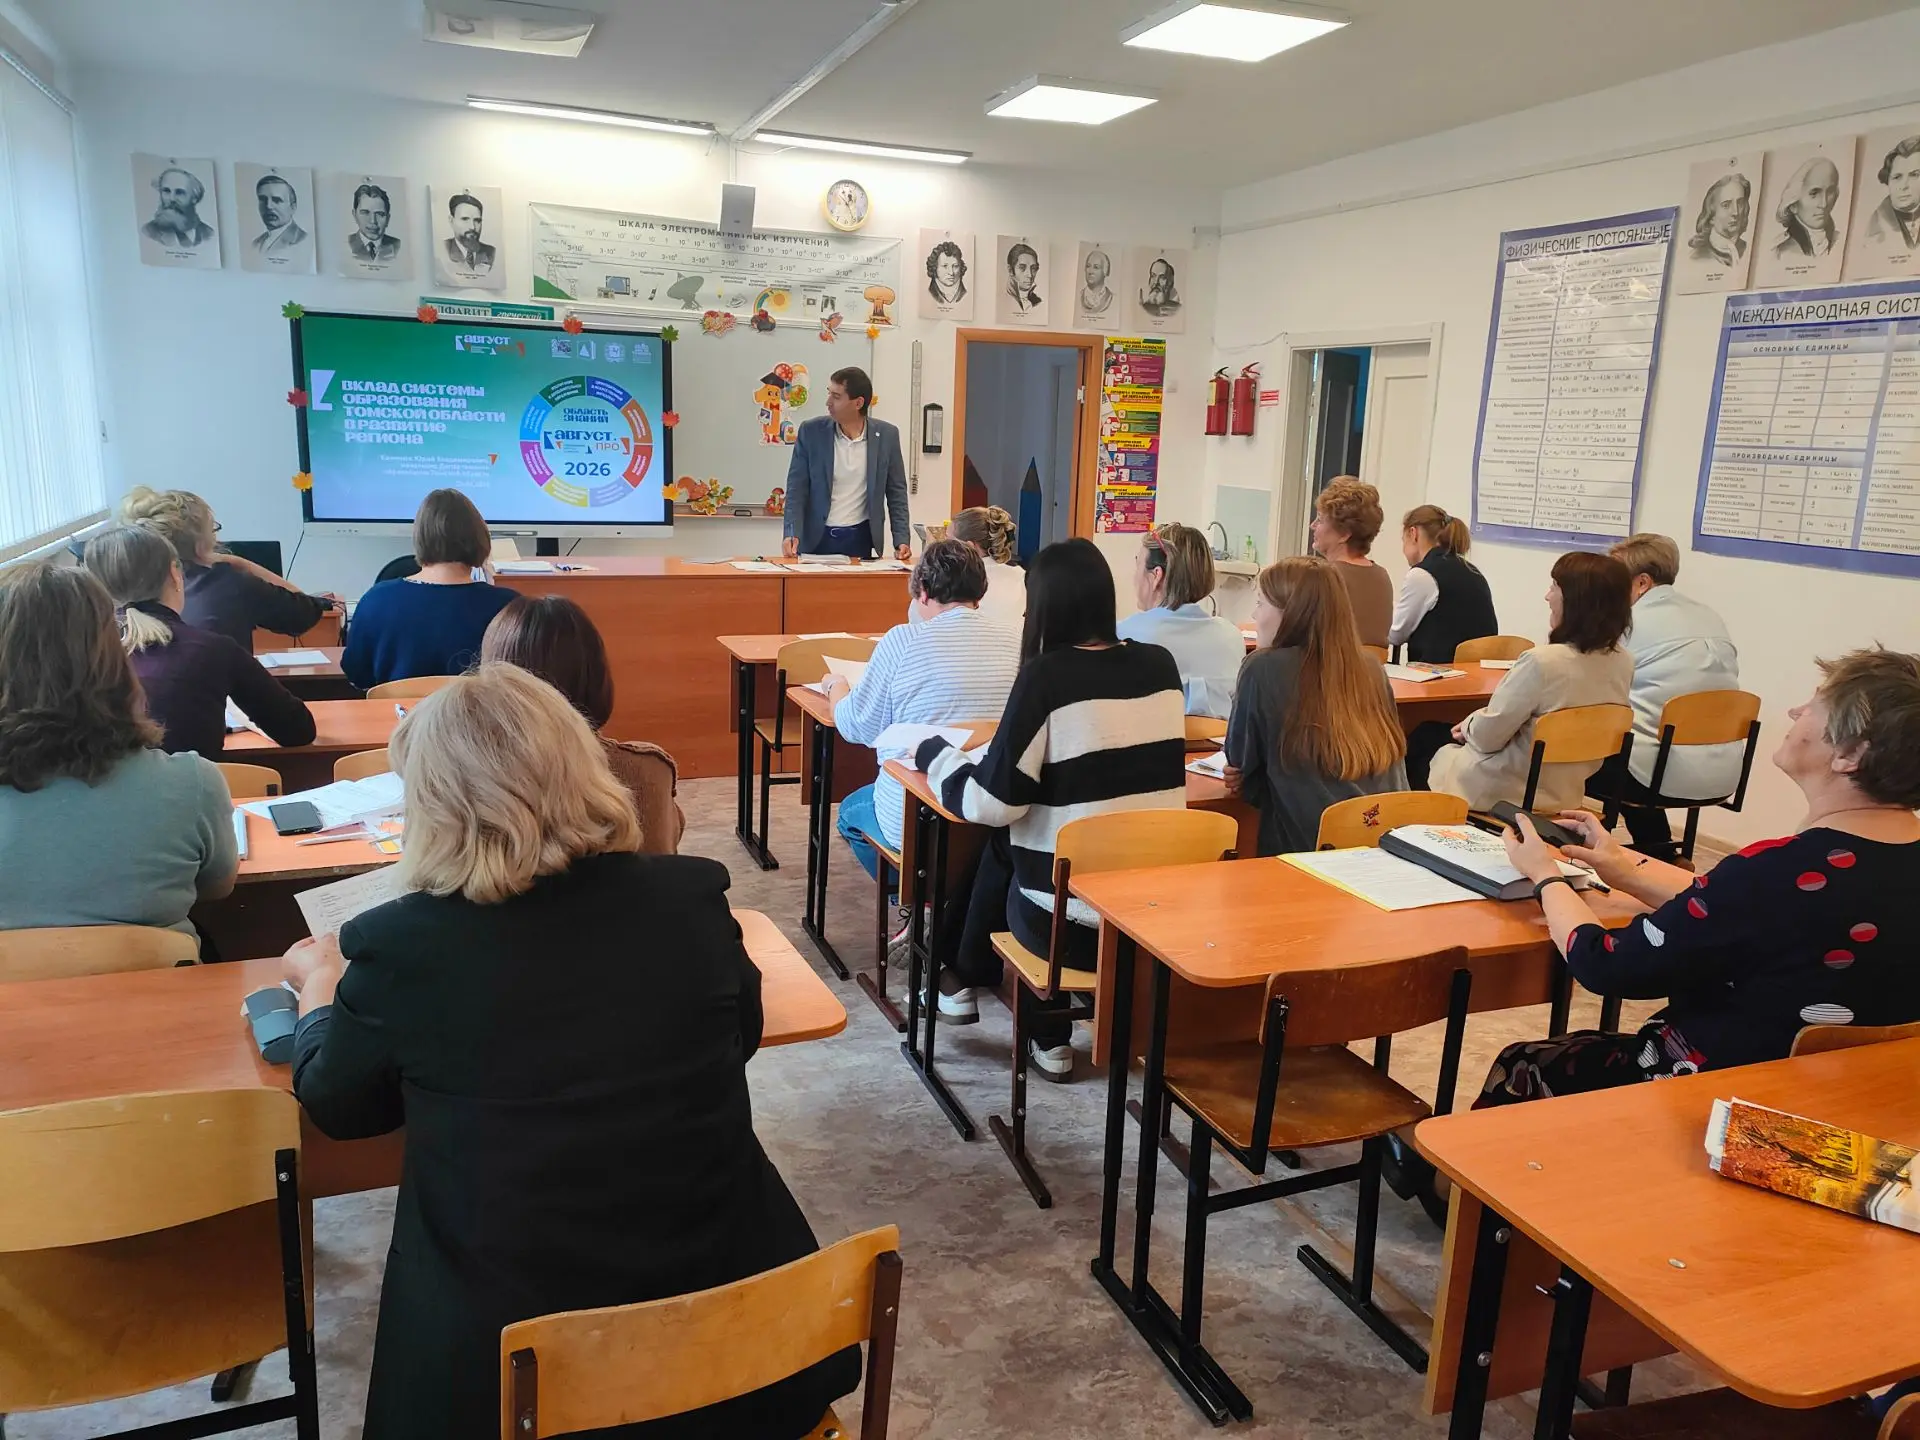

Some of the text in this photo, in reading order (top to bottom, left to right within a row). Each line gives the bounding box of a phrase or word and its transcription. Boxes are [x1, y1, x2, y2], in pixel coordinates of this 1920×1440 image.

[618, 219, 655, 230] ШКАЛА
[773, 236, 831, 247] ИЗЛУЧЕНИЙ
[1505, 224, 1671, 257] ФИЗИЧЕСКИЕ ПОСТОЯННЫЕ
[1731, 301, 1871, 324] МЕЖДУНАРОДНАЯ
[1753, 343, 1850, 353] ОСНОВНЫЕ ЕДИНИЦЫ
[596, 442, 620, 451] ПРО
[1731, 452, 1838, 463] ПРОИЗВОДНЫЕ ЕДИНИЦЫ
[564, 461, 612, 476] 2026
